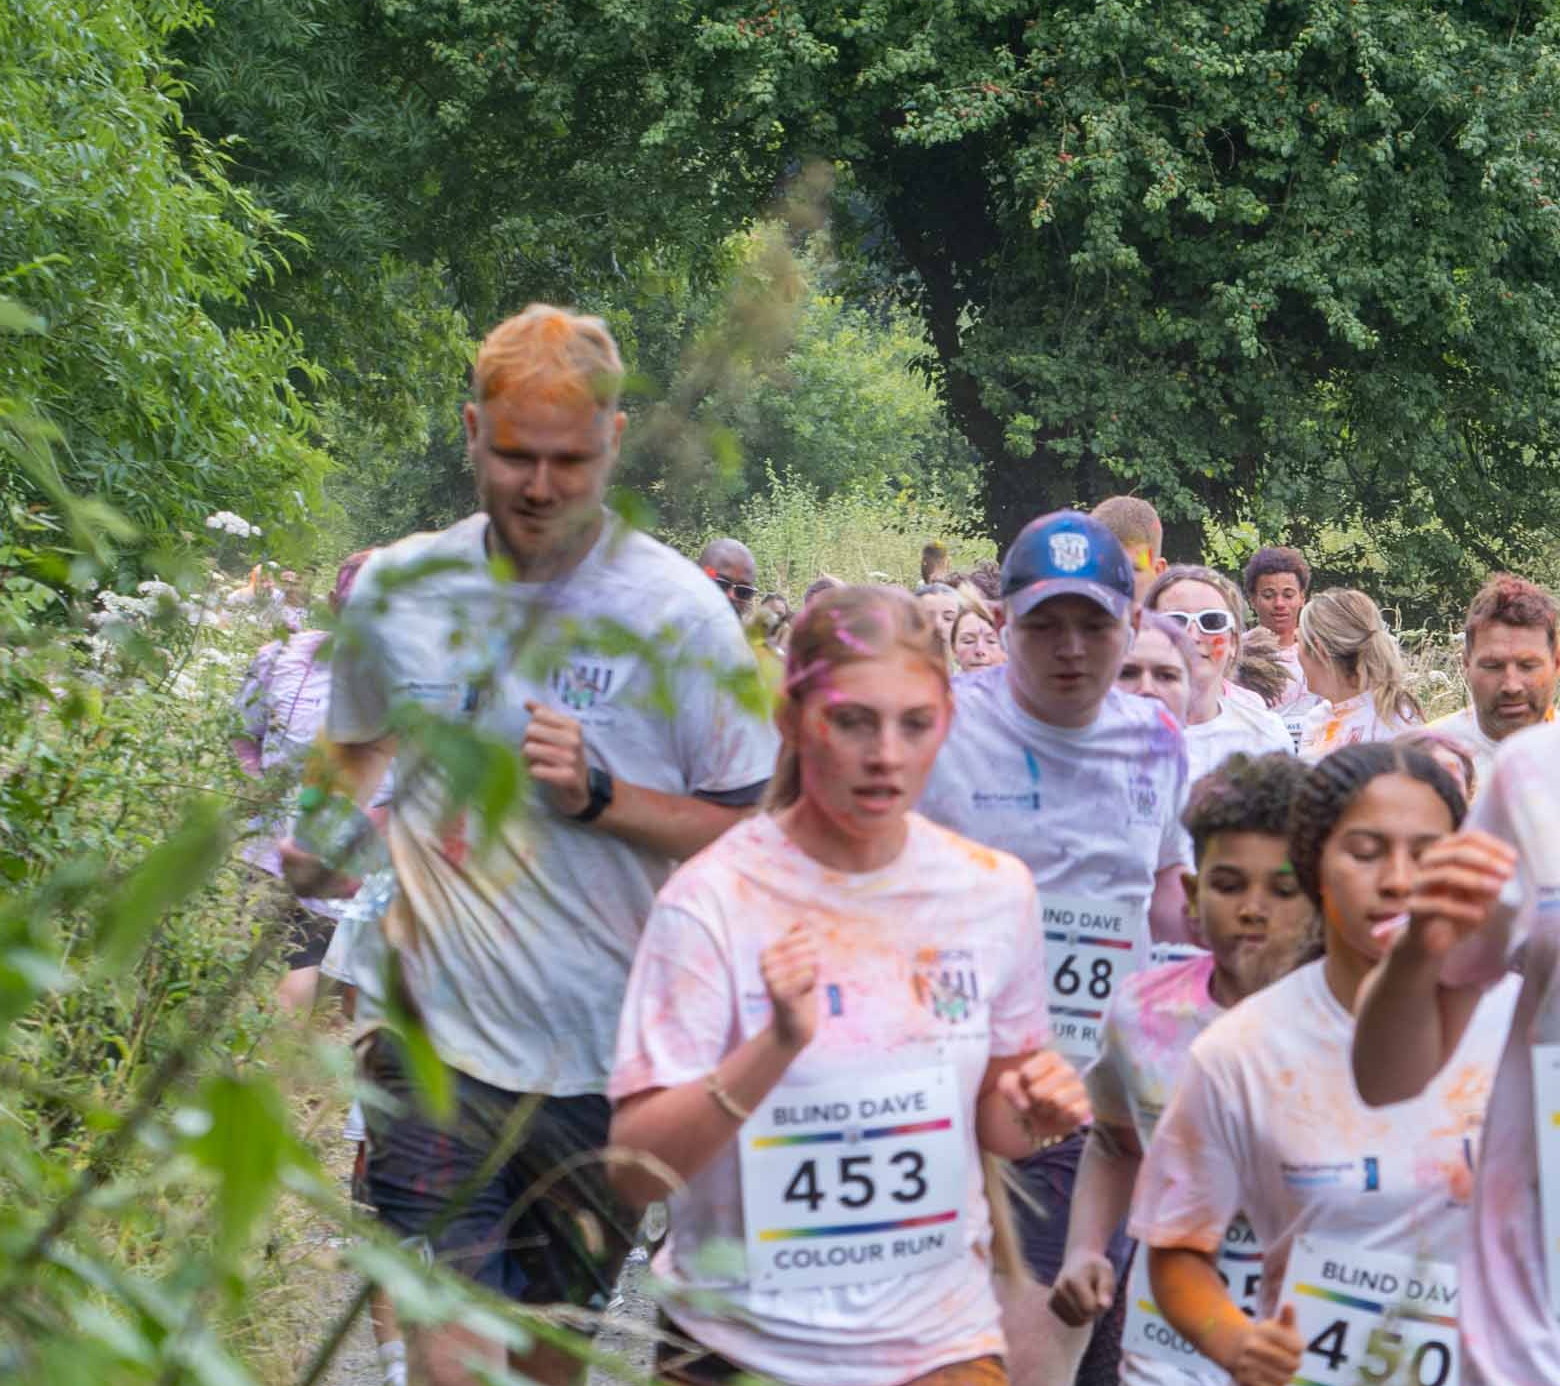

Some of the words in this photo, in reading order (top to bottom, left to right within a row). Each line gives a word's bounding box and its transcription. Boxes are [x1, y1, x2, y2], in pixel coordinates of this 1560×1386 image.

[1042, 908, 1073, 927] IND
[1080, 912, 1123, 933] DAVE
[1053, 954, 1113, 1000] 68
[773, 1102, 852, 1126] BLIND
[858, 1091, 927, 1120] DAVE
[783, 1150, 928, 1212] 453
[773, 1243, 885, 1270] COLOUR
[892, 1233, 943, 1258] RUN
[1321, 1261, 1398, 1296] BLIND
[1404, 1279, 1458, 1306] DAV
[1144, 1322, 1195, 1355] COLO
